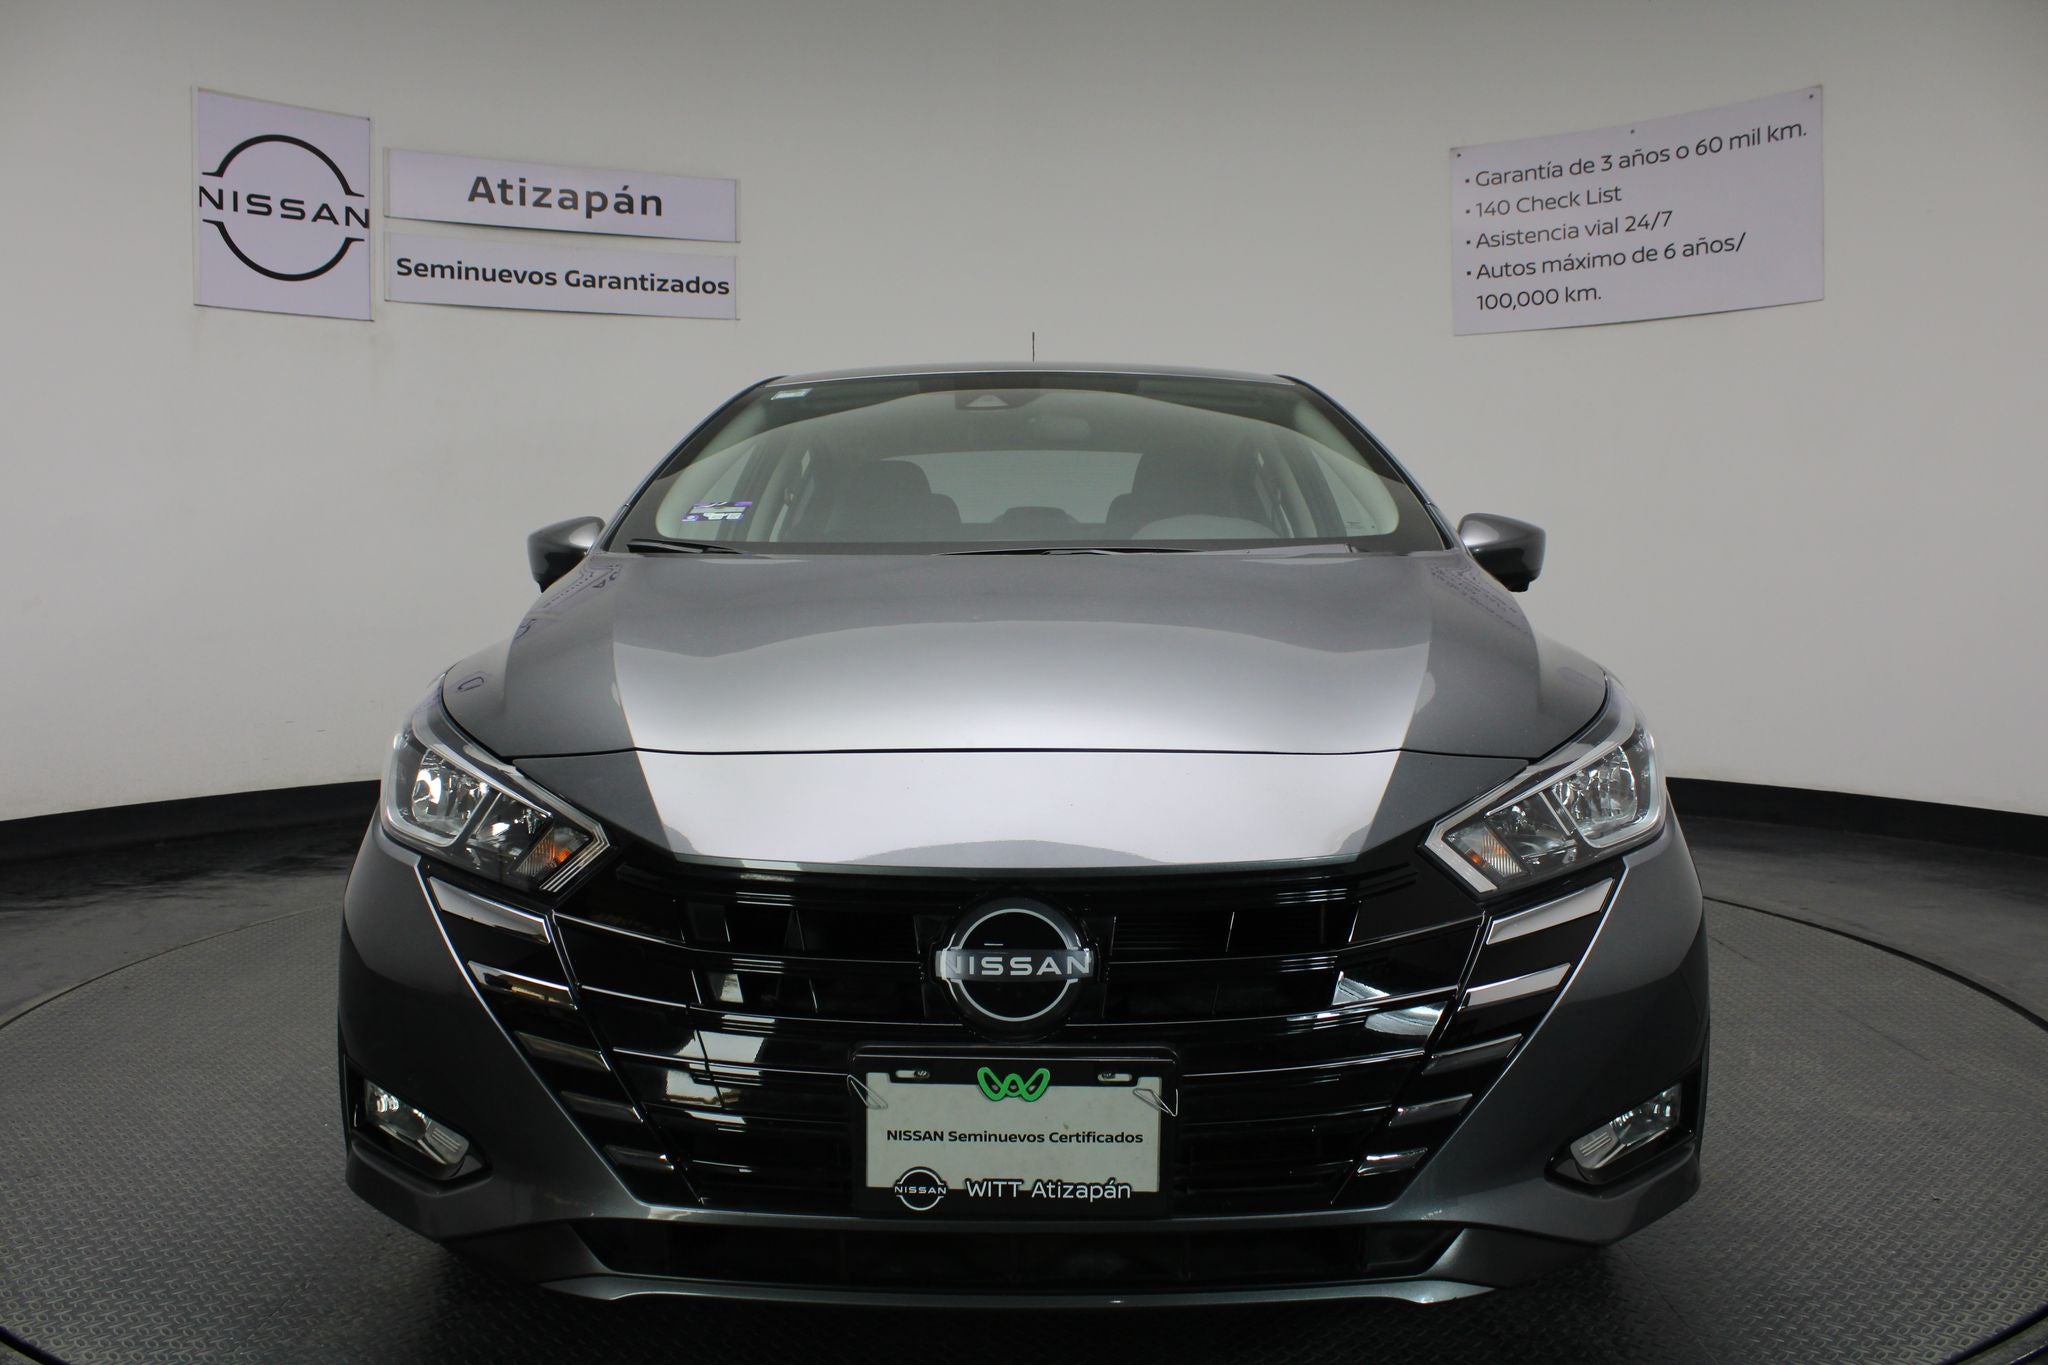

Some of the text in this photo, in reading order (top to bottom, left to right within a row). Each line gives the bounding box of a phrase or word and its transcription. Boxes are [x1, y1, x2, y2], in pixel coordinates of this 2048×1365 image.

[1476, 122, 1807, 186] Garantía de 3 años o 60 mil km.
[199, 186, 369, 229] NISSAN
[468, 176, 662, 219] Atizapán
[1476, 186, 1622, 217] 140 Check List
[1476, 210, 1673, 248] Asistencia vial 24/7
[1476, 231, 1747, 280] Autos máximo de 6 años/
[397, 258, 730, 296] Seminuevos Garantizados
[1476, 286, 1602, 311] 100,000 km.
[944, 956, 1090, 976] NISSAN
[887, 1130, 1144, 1144] NISSAN Seminuevos Certificados
[894, 1185, 947, 1195] NISSAN
[966, 1179, 1131, 1203] WITT Atizapán
